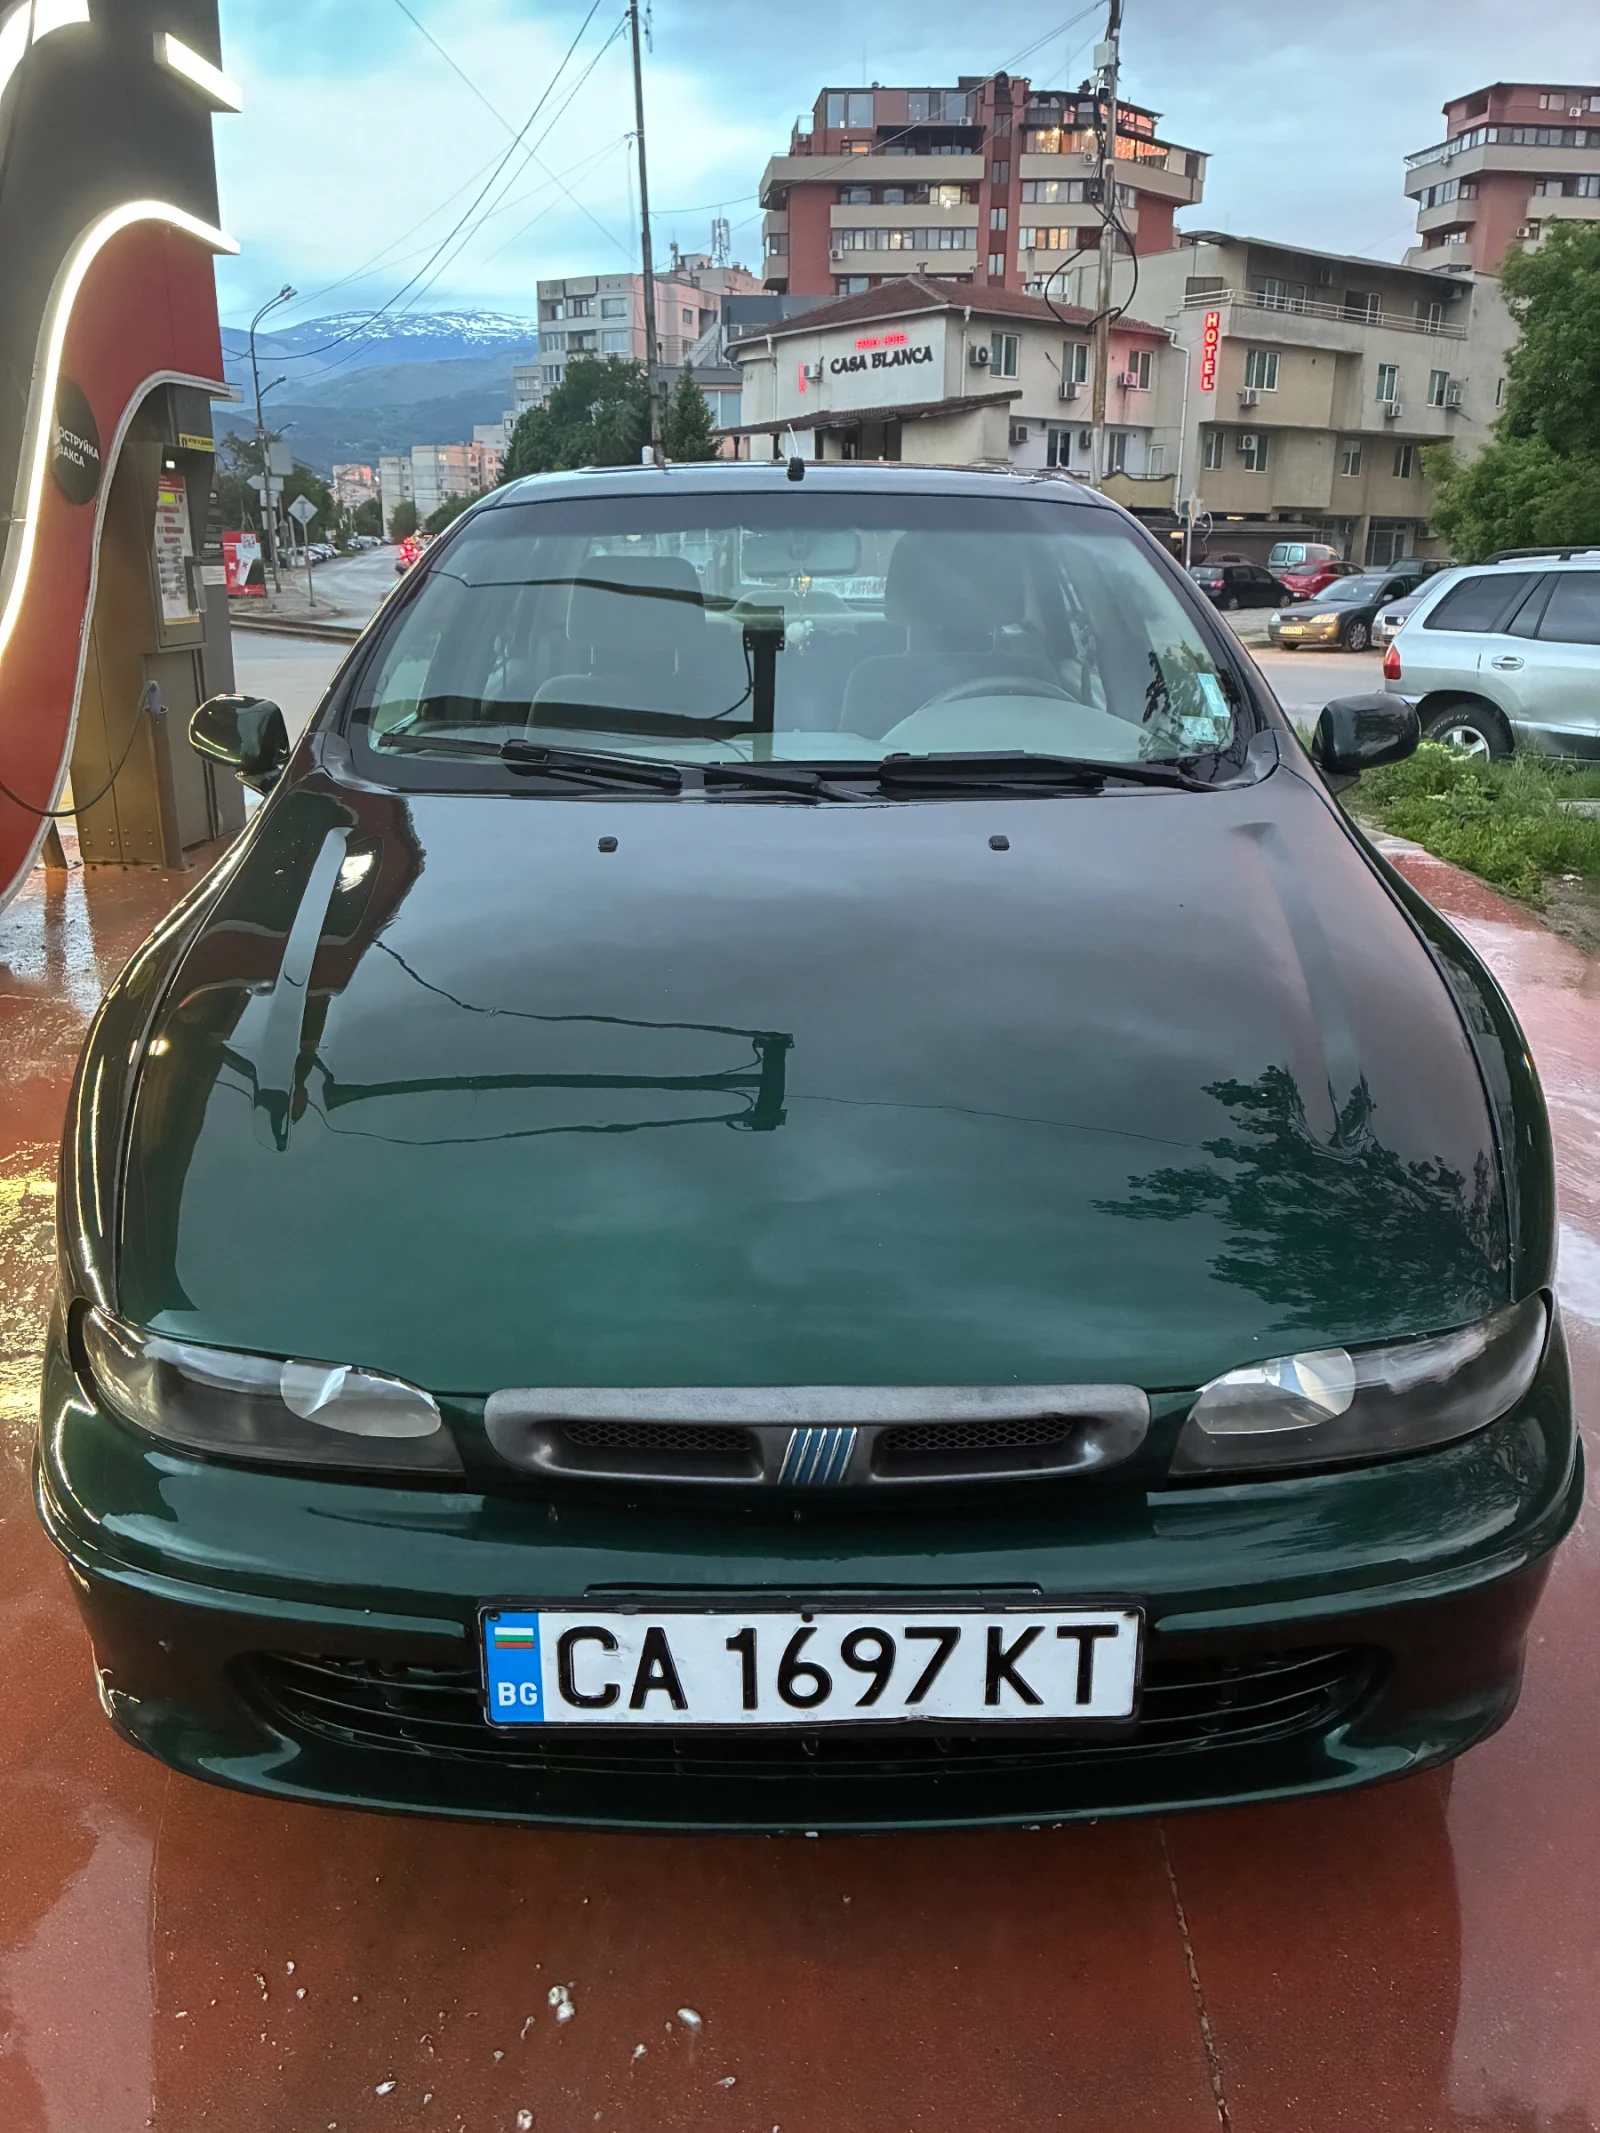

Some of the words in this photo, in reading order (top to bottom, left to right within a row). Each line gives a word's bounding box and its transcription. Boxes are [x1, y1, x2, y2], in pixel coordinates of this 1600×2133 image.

[883, 333, 909, 346] HOTEL
[1202, 312, 1219, 391] HOTEL
[830, 355, 868, 374] CASA
[871, 345, 934, 370] BLANCA
[557, 1625, 688, 1710] CA
[725, 1626, 962, 1710] 1697
[984, 1624, 1119, 1706] KT
[497, 1681, 538, 1707] BG
